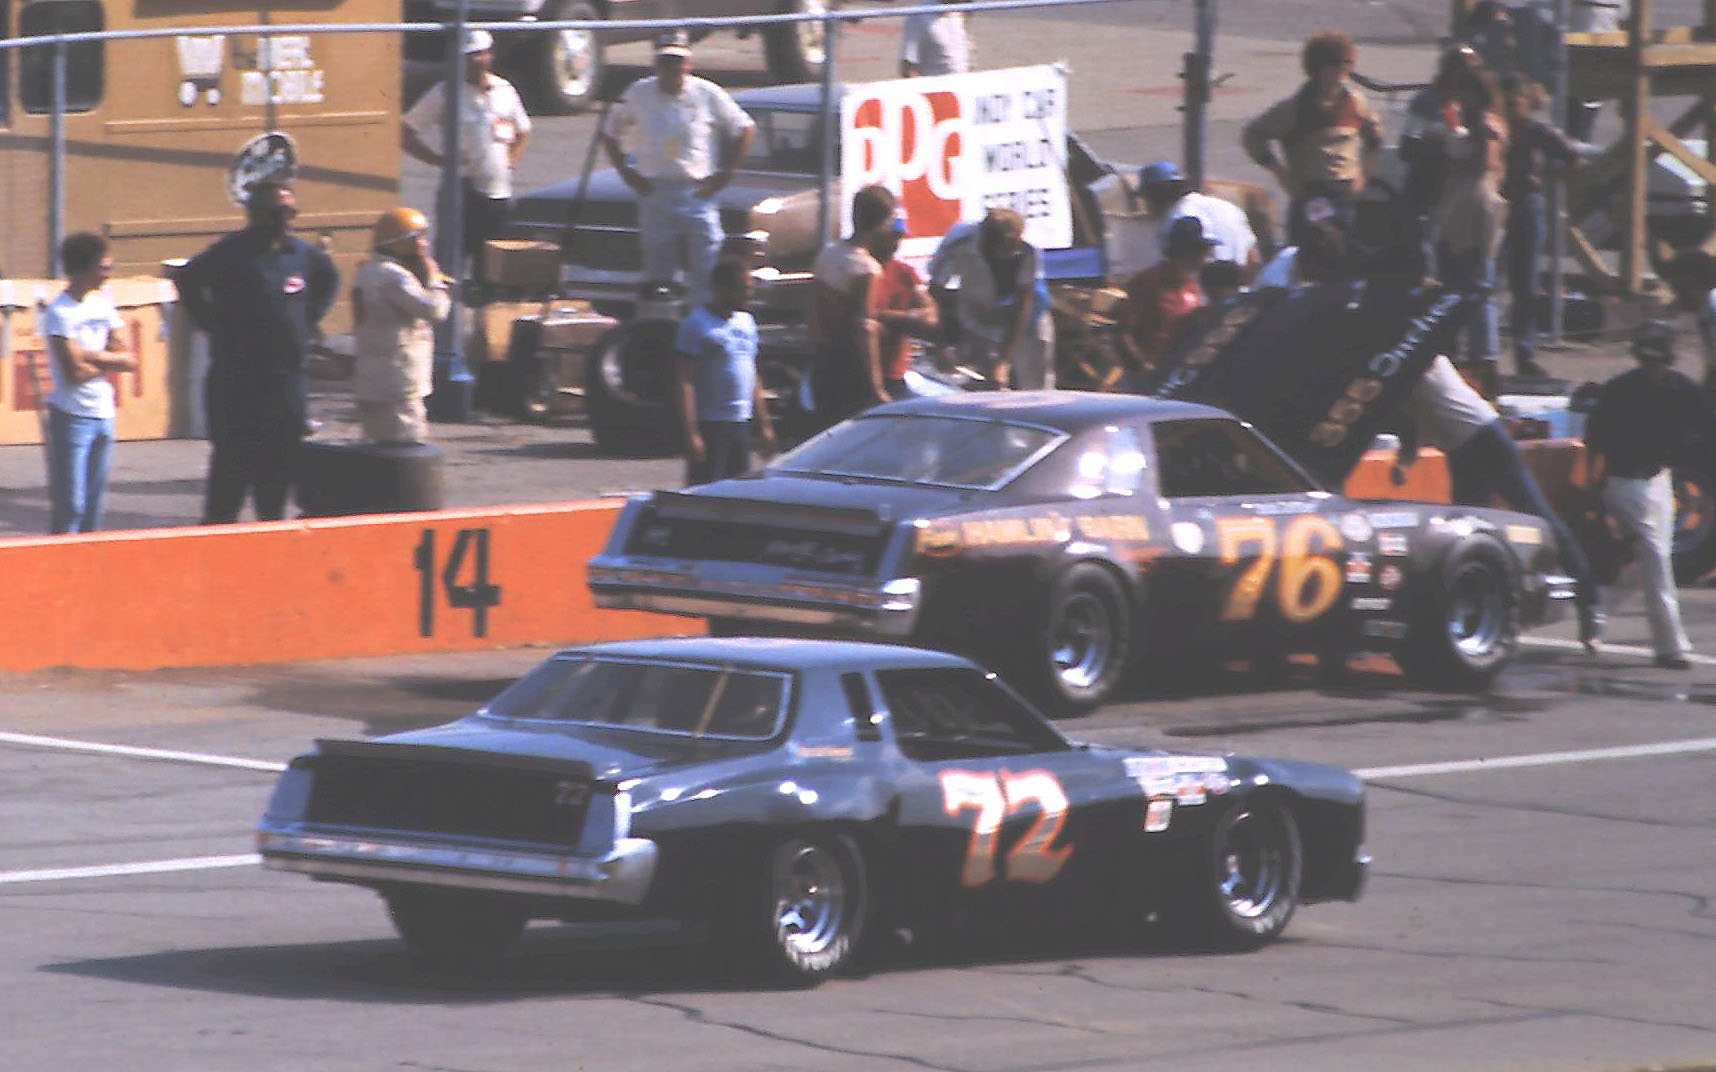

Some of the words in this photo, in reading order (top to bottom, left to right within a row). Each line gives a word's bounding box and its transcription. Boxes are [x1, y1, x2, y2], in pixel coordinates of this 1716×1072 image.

[850, 91, 962, 238] PPG
[982, 137, 1049, 173] WORLD
[413, 528, 501, 637] 14
[1216, 512, 1343, 623] 76
[938, 767, 1075, 888] 72
